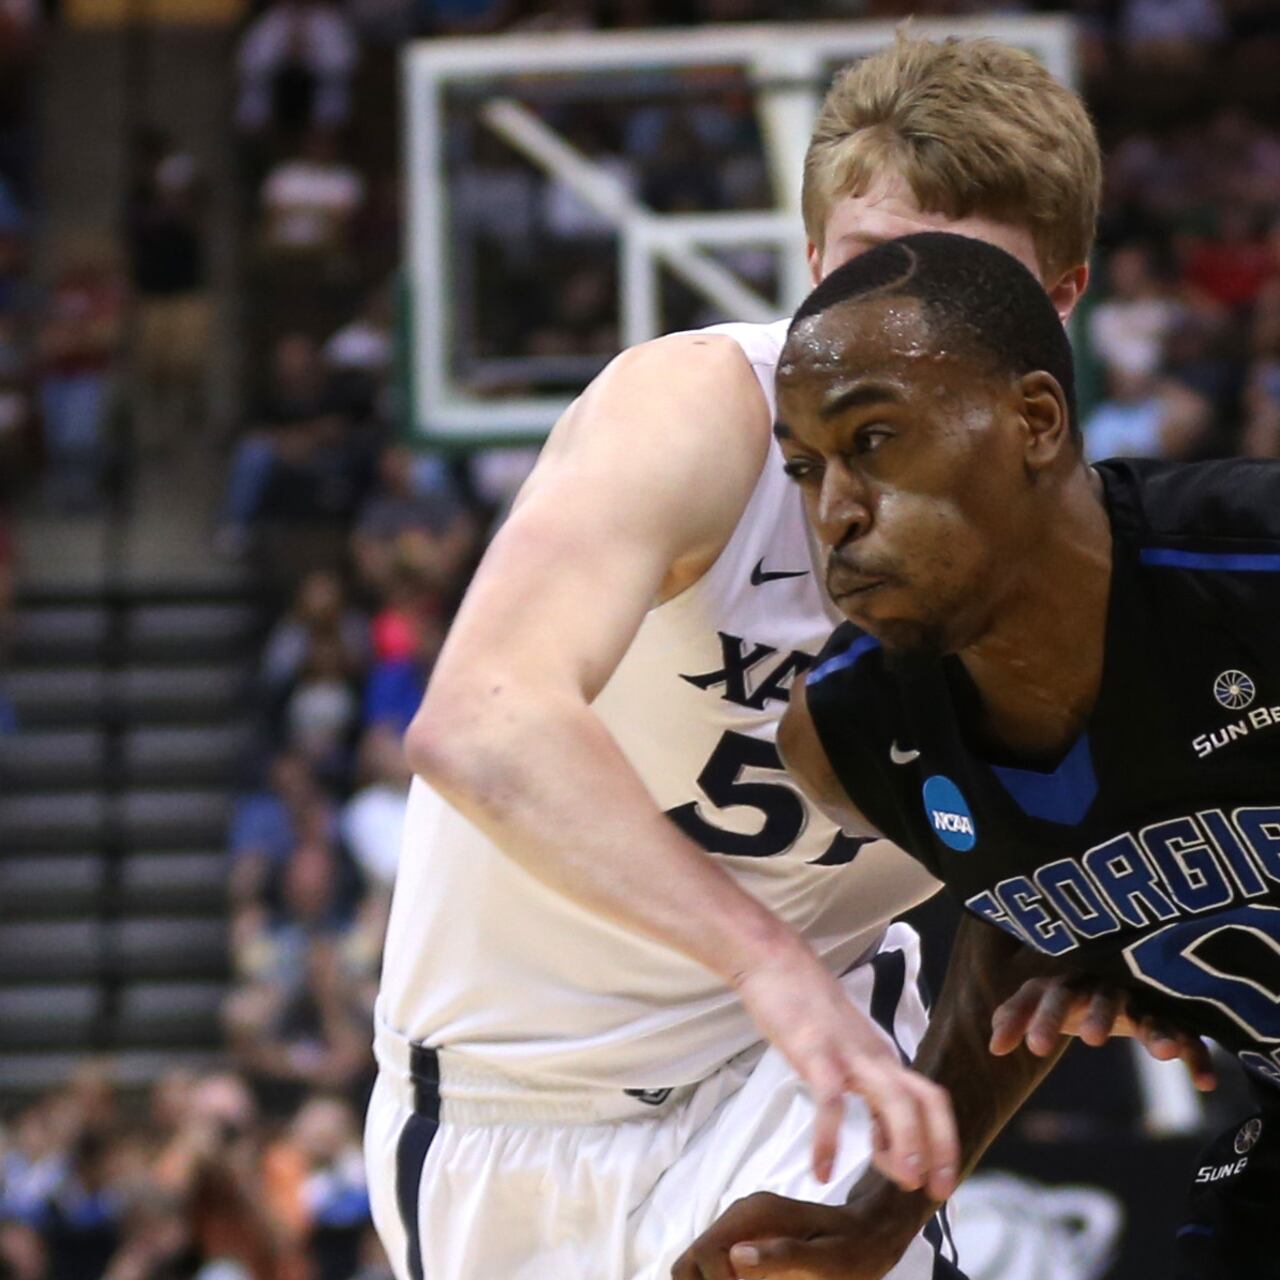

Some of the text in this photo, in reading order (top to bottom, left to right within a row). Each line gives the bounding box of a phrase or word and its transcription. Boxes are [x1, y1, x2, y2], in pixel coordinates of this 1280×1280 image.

[1192, 720, 1249, 758] SUN
[663, 729, 884, 867] 5
[932, 810, 975, 836] NCAA
[1195, 1163, 1235, 1183] SUN
